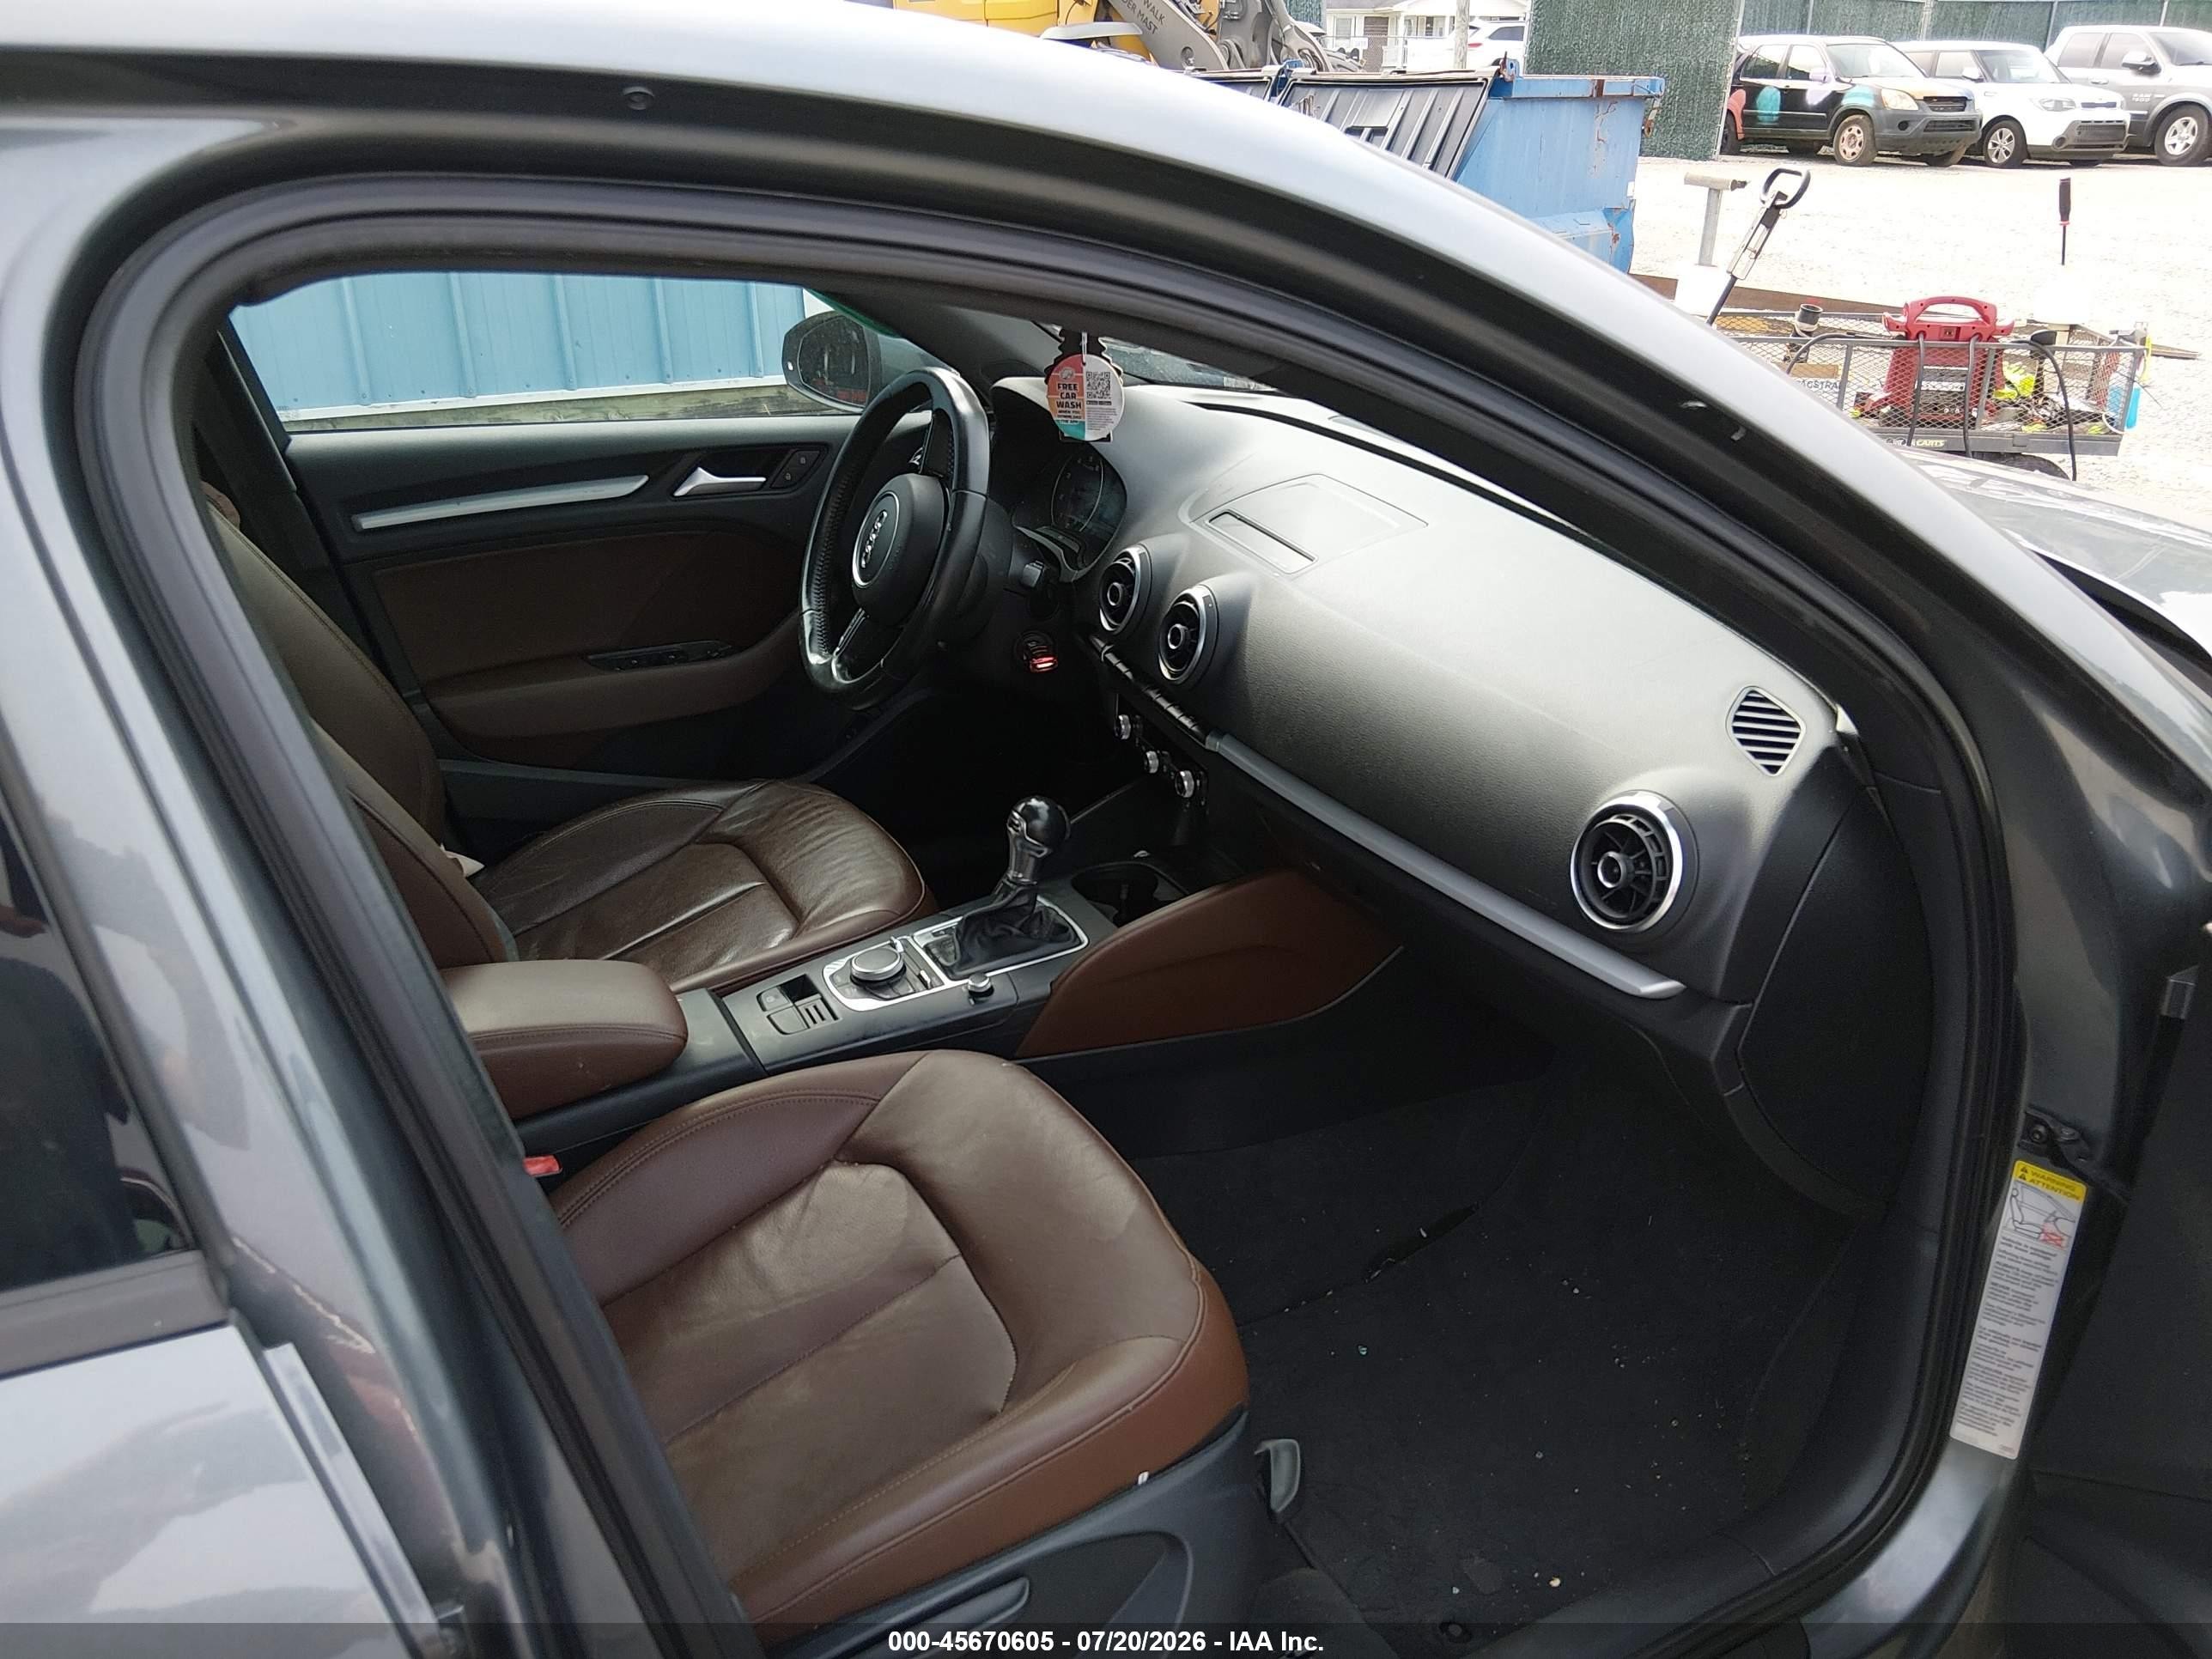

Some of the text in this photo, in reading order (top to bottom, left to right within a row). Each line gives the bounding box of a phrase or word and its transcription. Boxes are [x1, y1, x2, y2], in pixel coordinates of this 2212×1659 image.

[1137, 9, 1158, 34] MAST
[1057, 383, 1079, 392] FREE
[1056, 400, 1082, 410] WASH
[1916, 439, 1945, 447] CARTS
[2031, 1170, 2075, 1190] WARNING
[2029, 1178, 2081, 1200] ATTENTION
